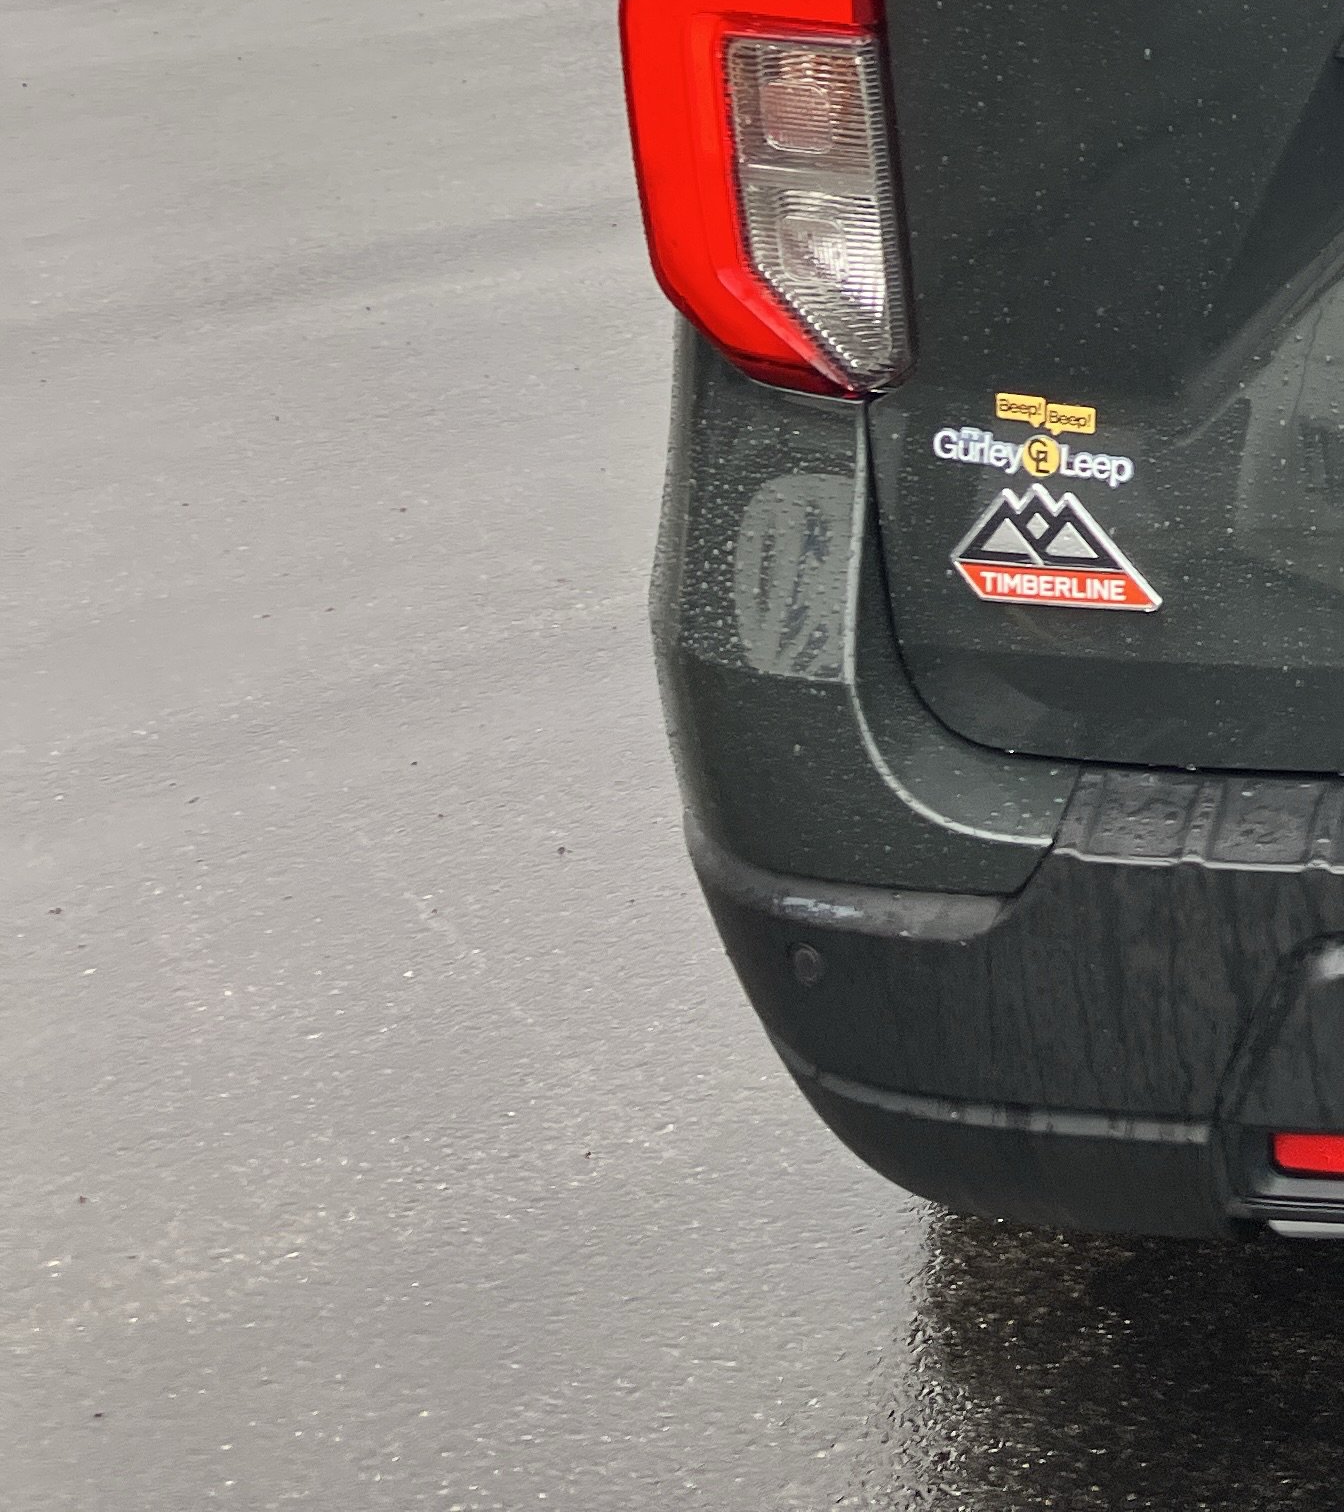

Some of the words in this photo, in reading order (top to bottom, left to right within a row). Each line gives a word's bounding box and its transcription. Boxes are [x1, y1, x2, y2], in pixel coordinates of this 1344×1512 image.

[999, 398, 1043, 418] Beep!
[1048, 410, 1093, 429] Beep!
[932, 427, 1025, 474] Gurley
[1058, 444, 1135, 488] Leep
[979, 570, 1128, 602] TIMBERLINE
